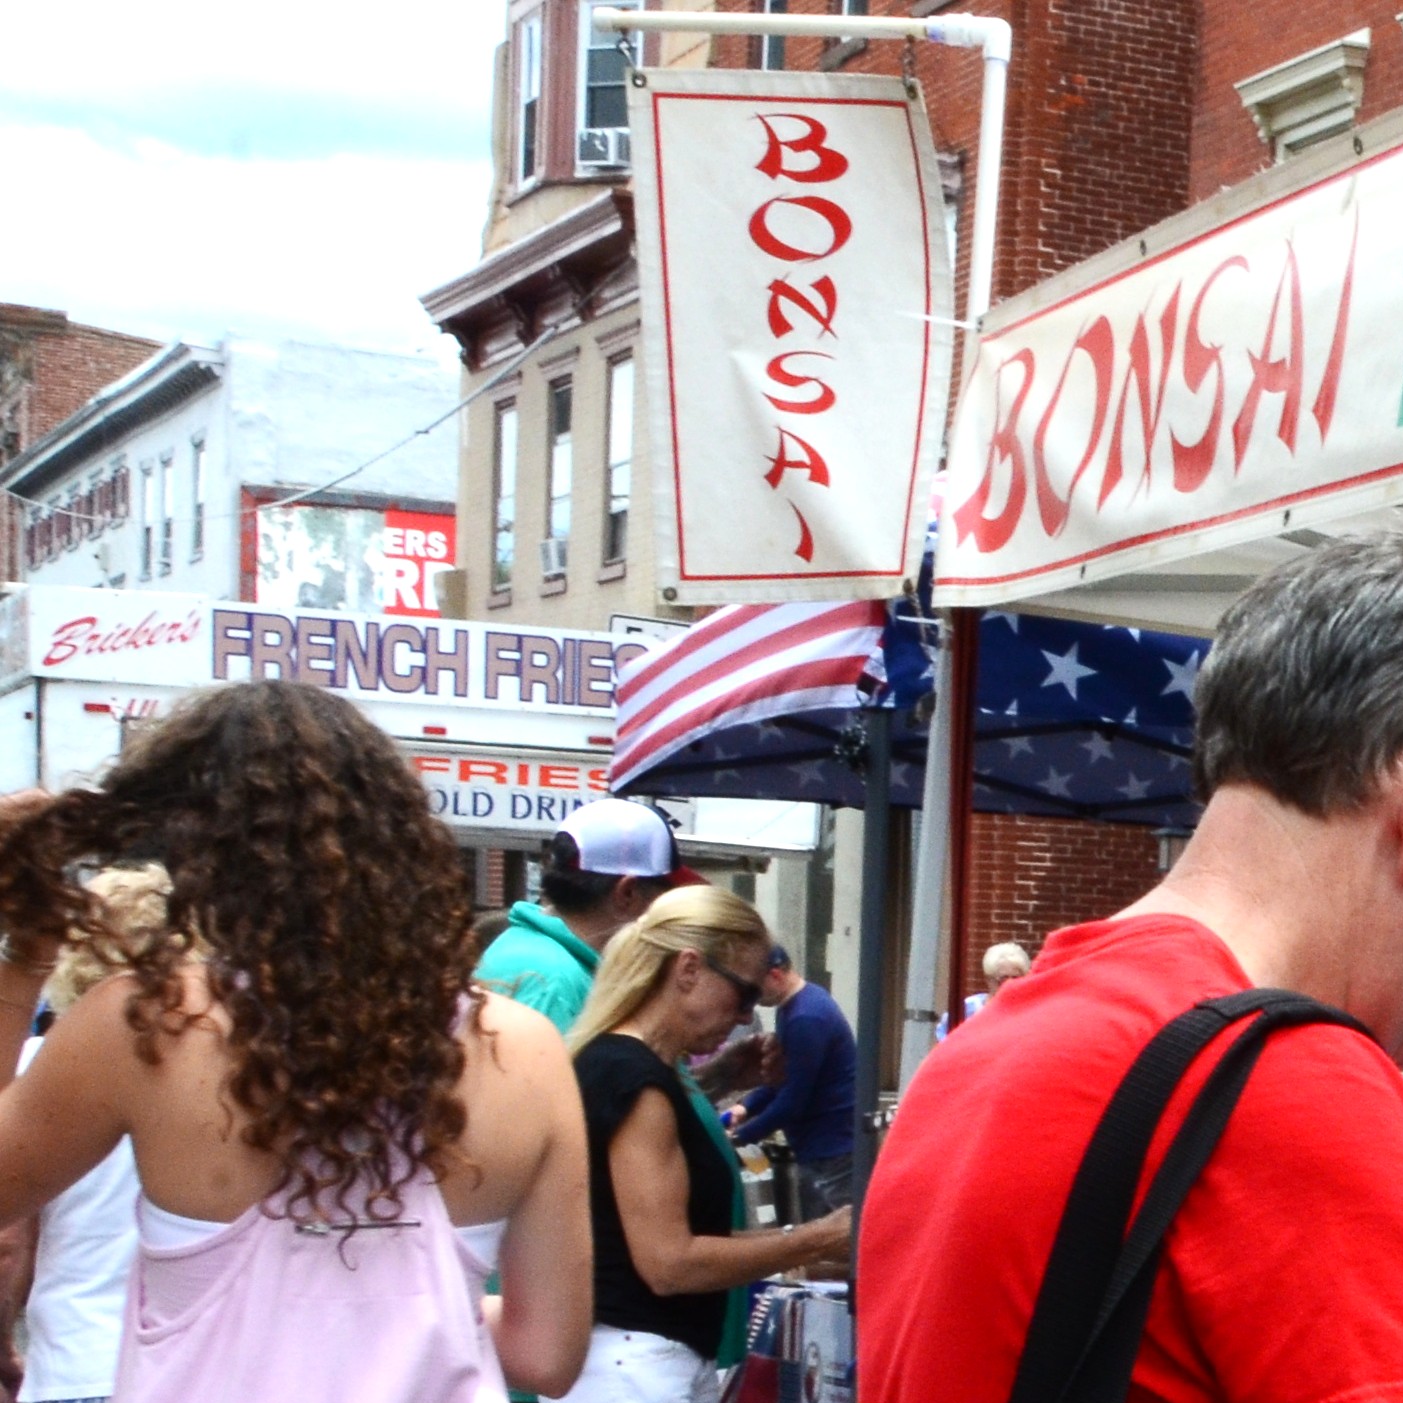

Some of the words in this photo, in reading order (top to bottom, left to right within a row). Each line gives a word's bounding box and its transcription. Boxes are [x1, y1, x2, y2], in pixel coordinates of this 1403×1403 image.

[748, 112, 852, 563] BONSAI
[952, 203, 1359, 553] BONSAI
[42, 609, 201, 666] Bricker's
[212, 608, 469, 698] FRENCH
